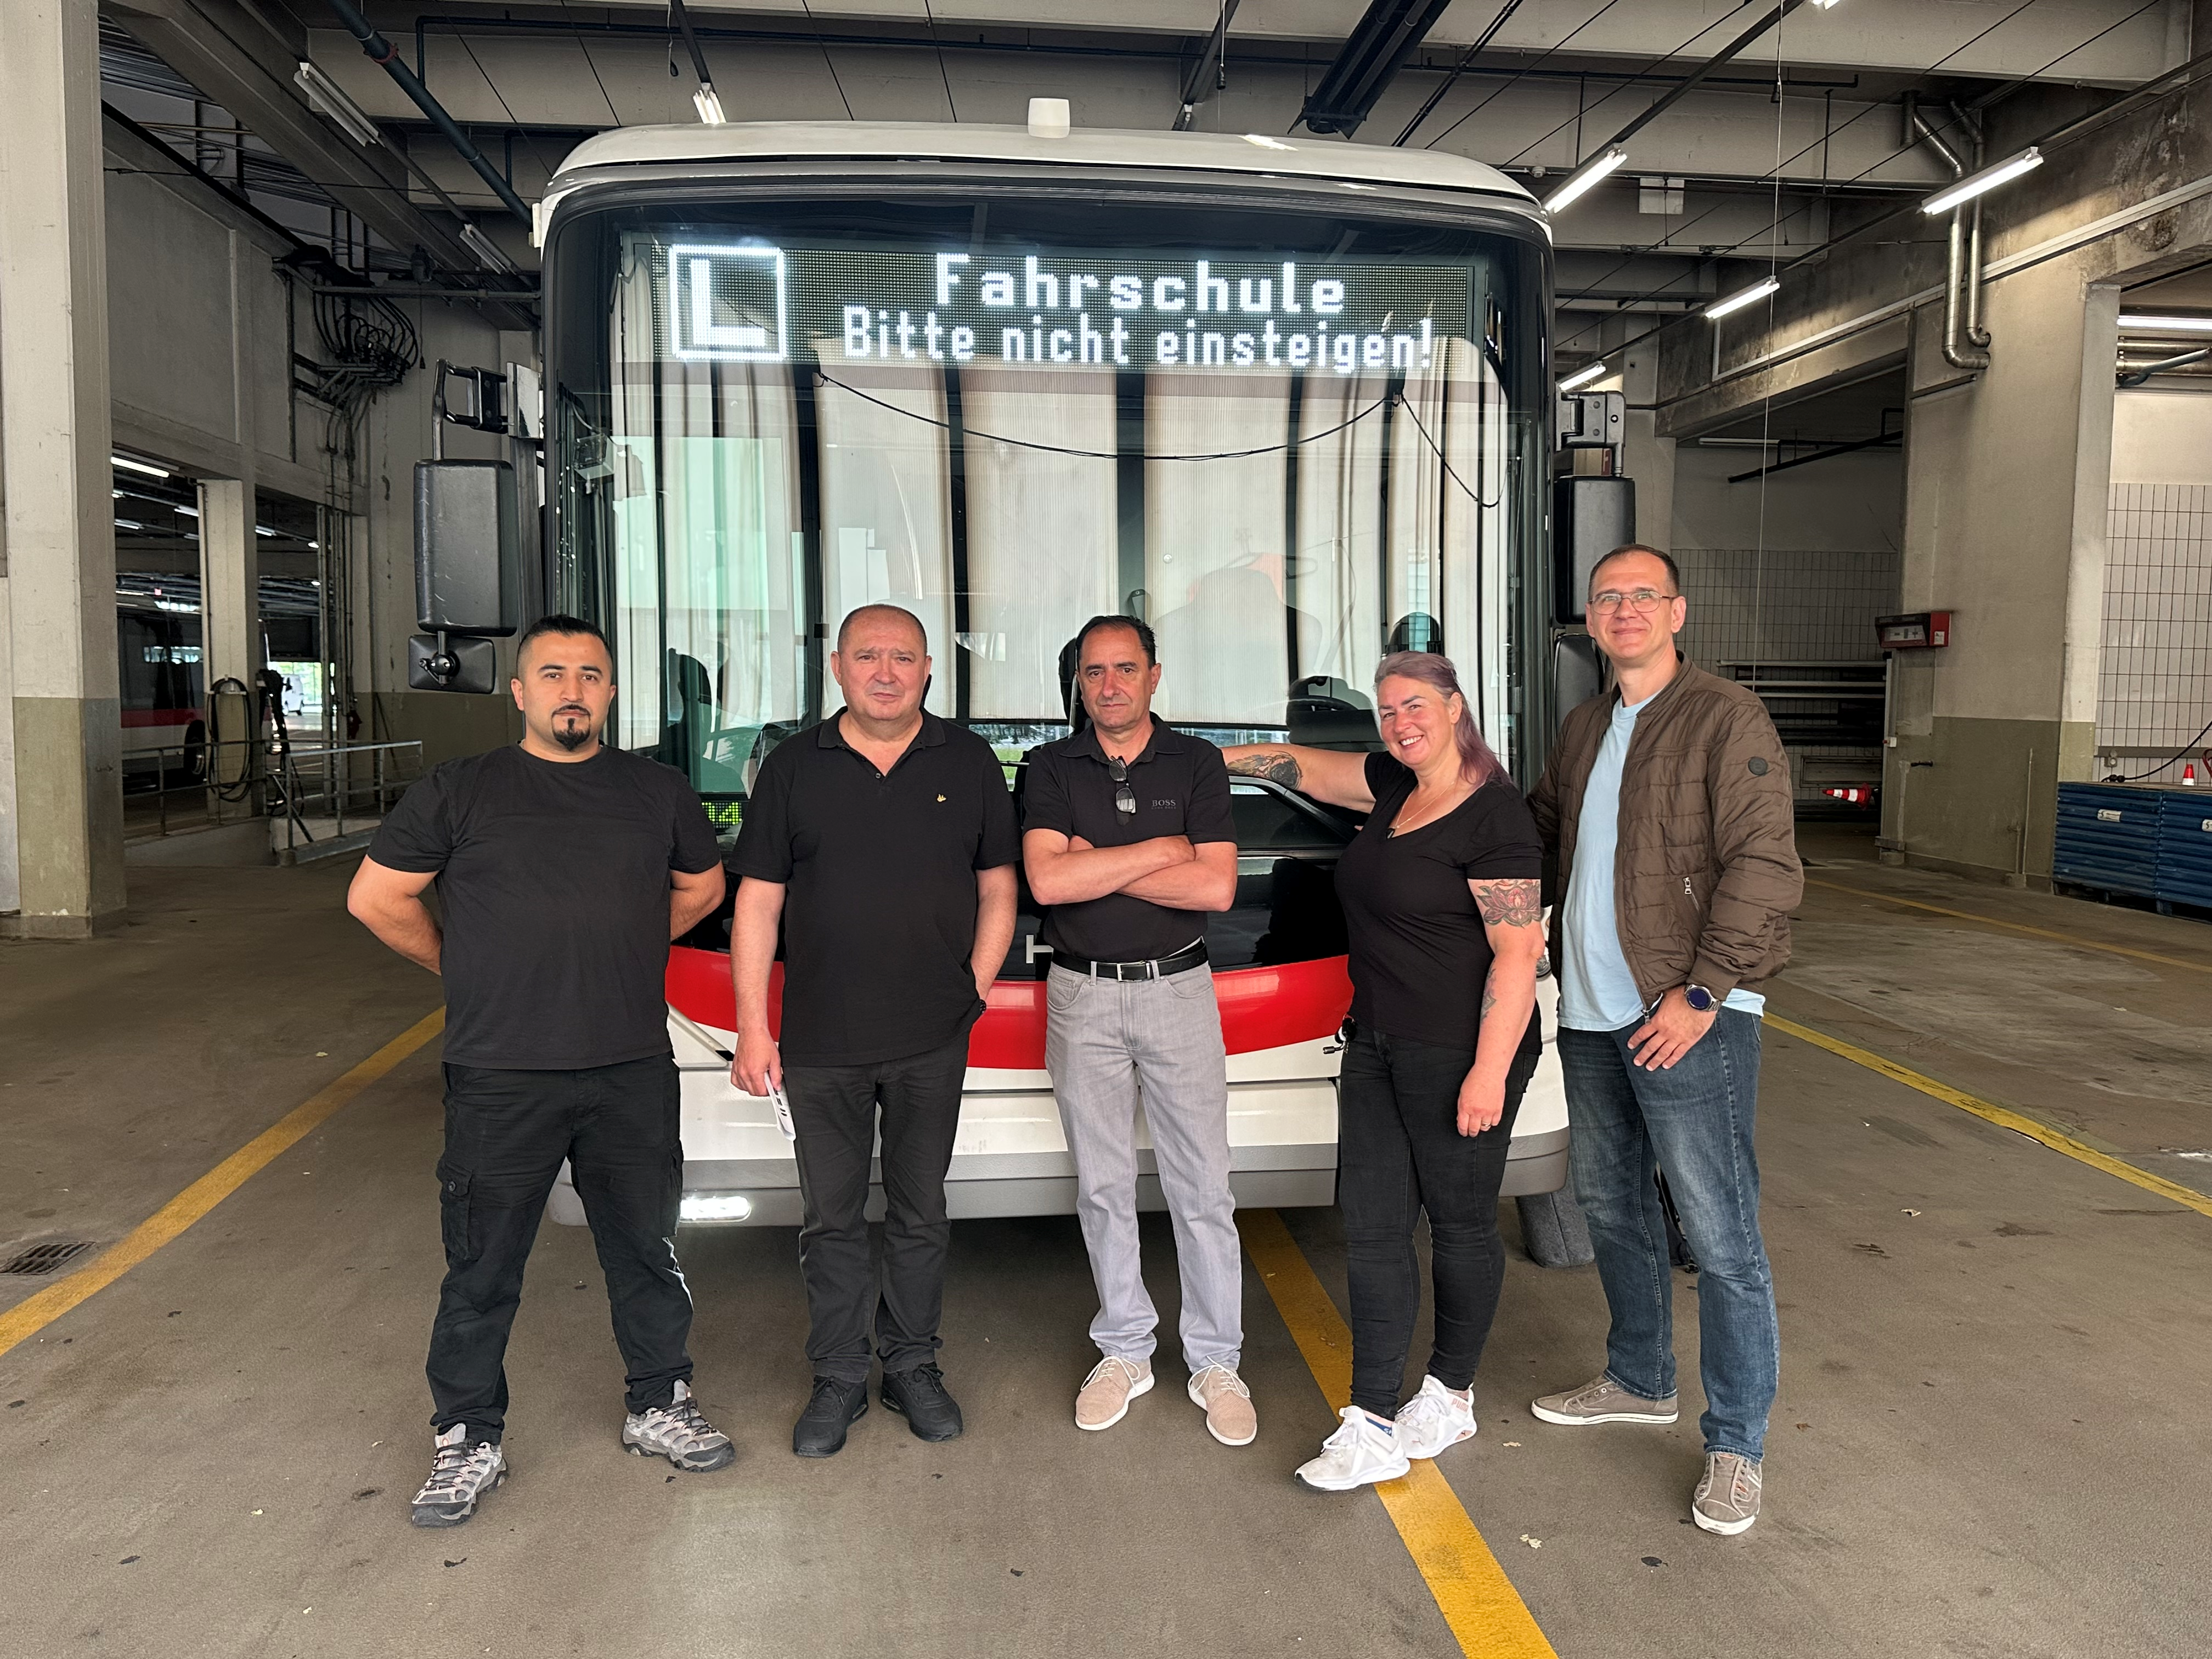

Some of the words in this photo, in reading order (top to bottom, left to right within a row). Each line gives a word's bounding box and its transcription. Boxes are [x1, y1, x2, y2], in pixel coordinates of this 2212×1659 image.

[690, 258, 765, 346] L
[936, 253, 1344, 313] Fahrschule
[844, 304, 974, 360] Bitte
[1003, 313, 1128, 364] nicht
[1156, 317, 1430, 374] einsteigen!
